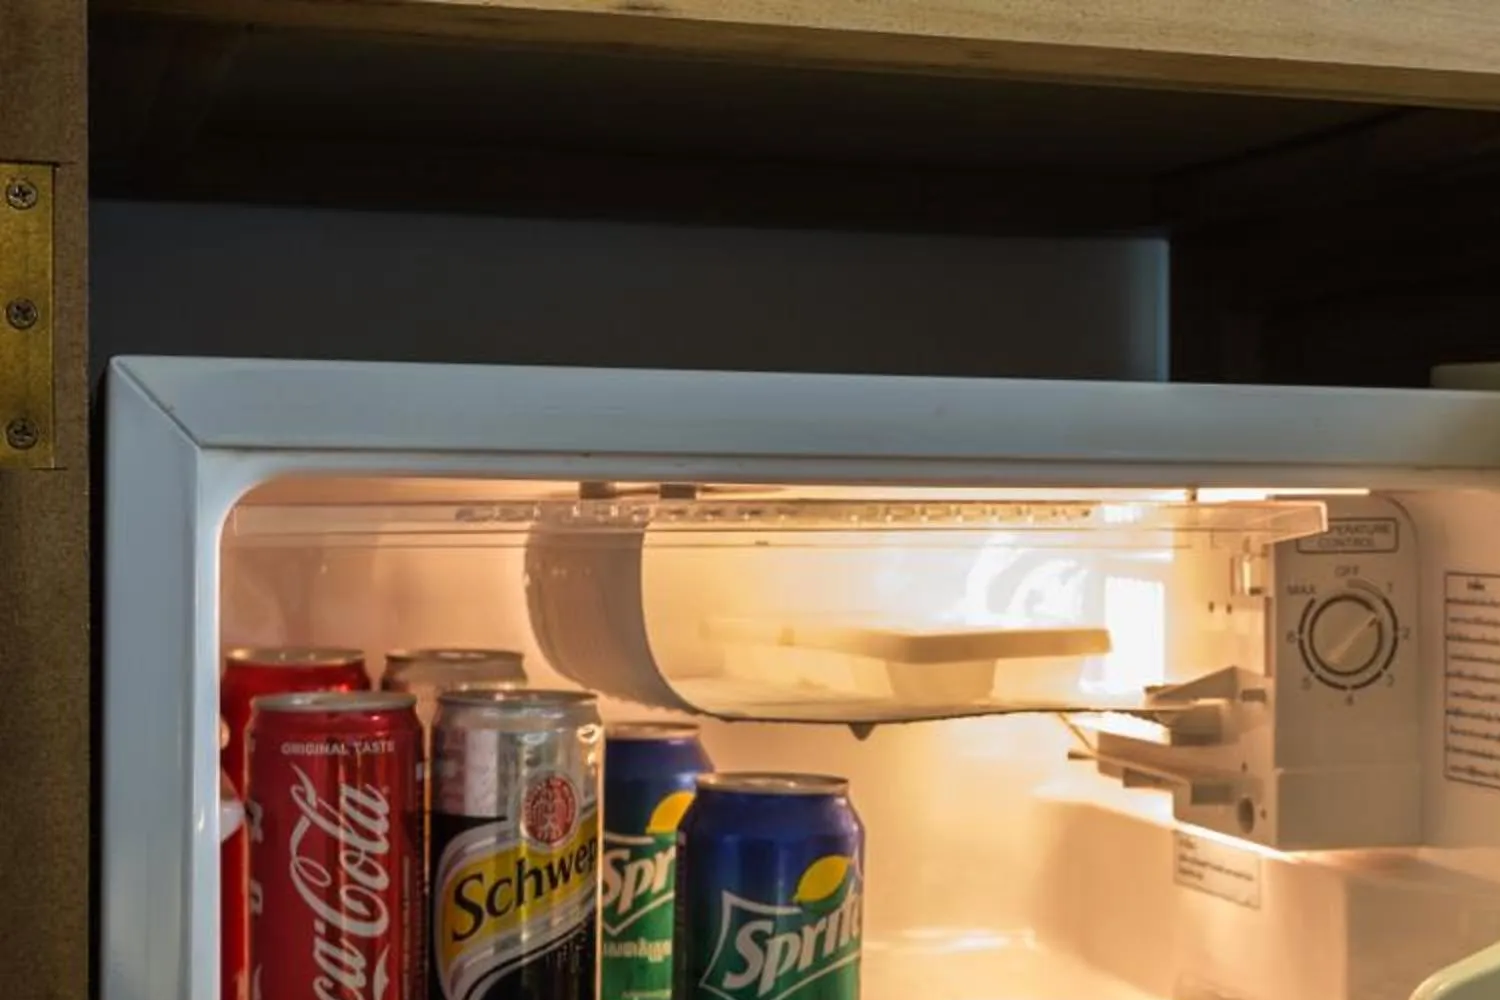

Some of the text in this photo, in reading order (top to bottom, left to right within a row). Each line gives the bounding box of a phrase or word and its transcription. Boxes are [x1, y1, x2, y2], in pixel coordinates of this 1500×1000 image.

[1286, 584, 1317, 596] MAX
[281, 739, 396, 756] ORIGINAL TASTE
[722, 880, 861, 998] Sprit
